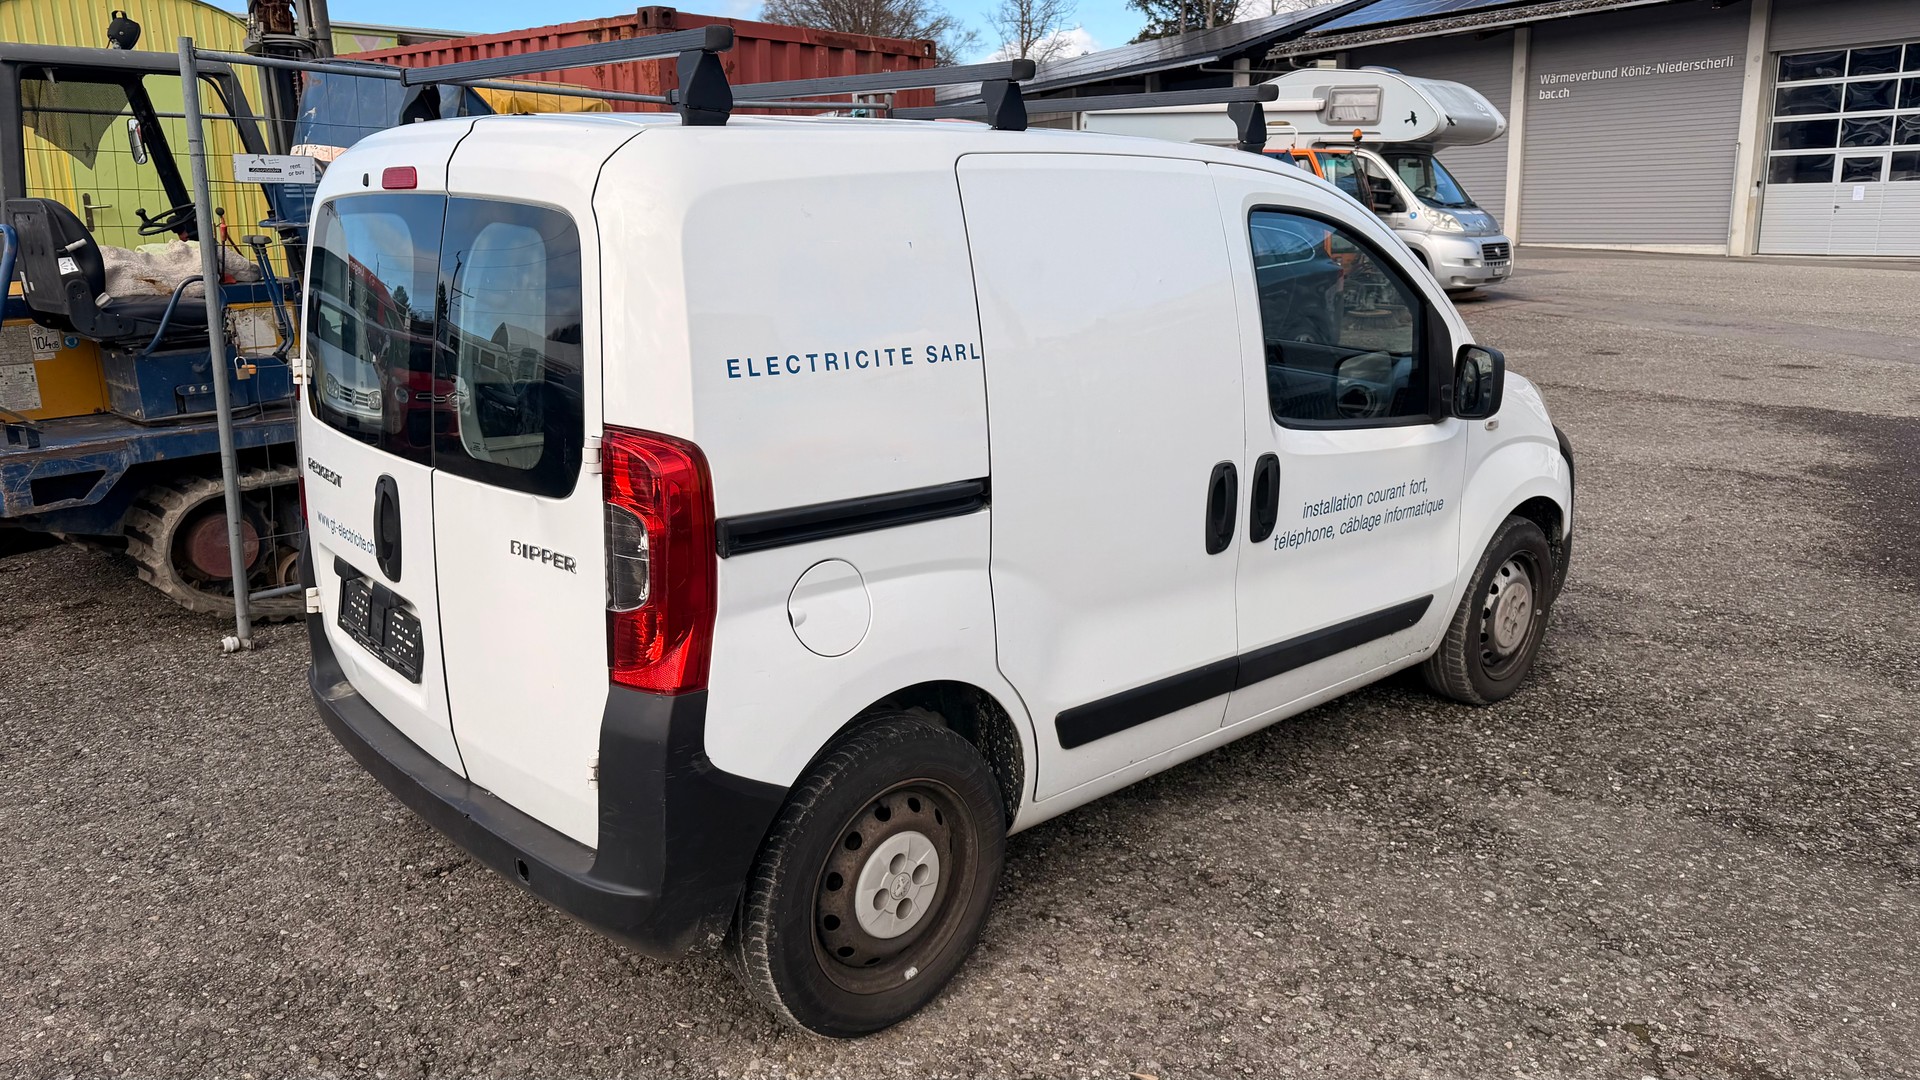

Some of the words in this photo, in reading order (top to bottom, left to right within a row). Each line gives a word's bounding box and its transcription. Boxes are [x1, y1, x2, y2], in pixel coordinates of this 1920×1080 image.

[1540, 67, 1618, 85] Wärmeverbund
[1621, 55, 1734, 78] Köniz-Niederscherli
[1539, 88, 1570, 100] bac.ch
[726, 347, 914, 379] ELECTRICITE
[926, 343, 981, 364] SARL
[1303, 493, 1363, 519] installation
[1367, 484, 1405, 505] courant
[1409, 477, 1428, 496] fort,
[1274, 525, 1336, 551] téléphone,
[1339, 514, 1382, 535] câblage
[1384, 498, 1444, 524] informatique
[510, 539, 577, 575] BIPPER
